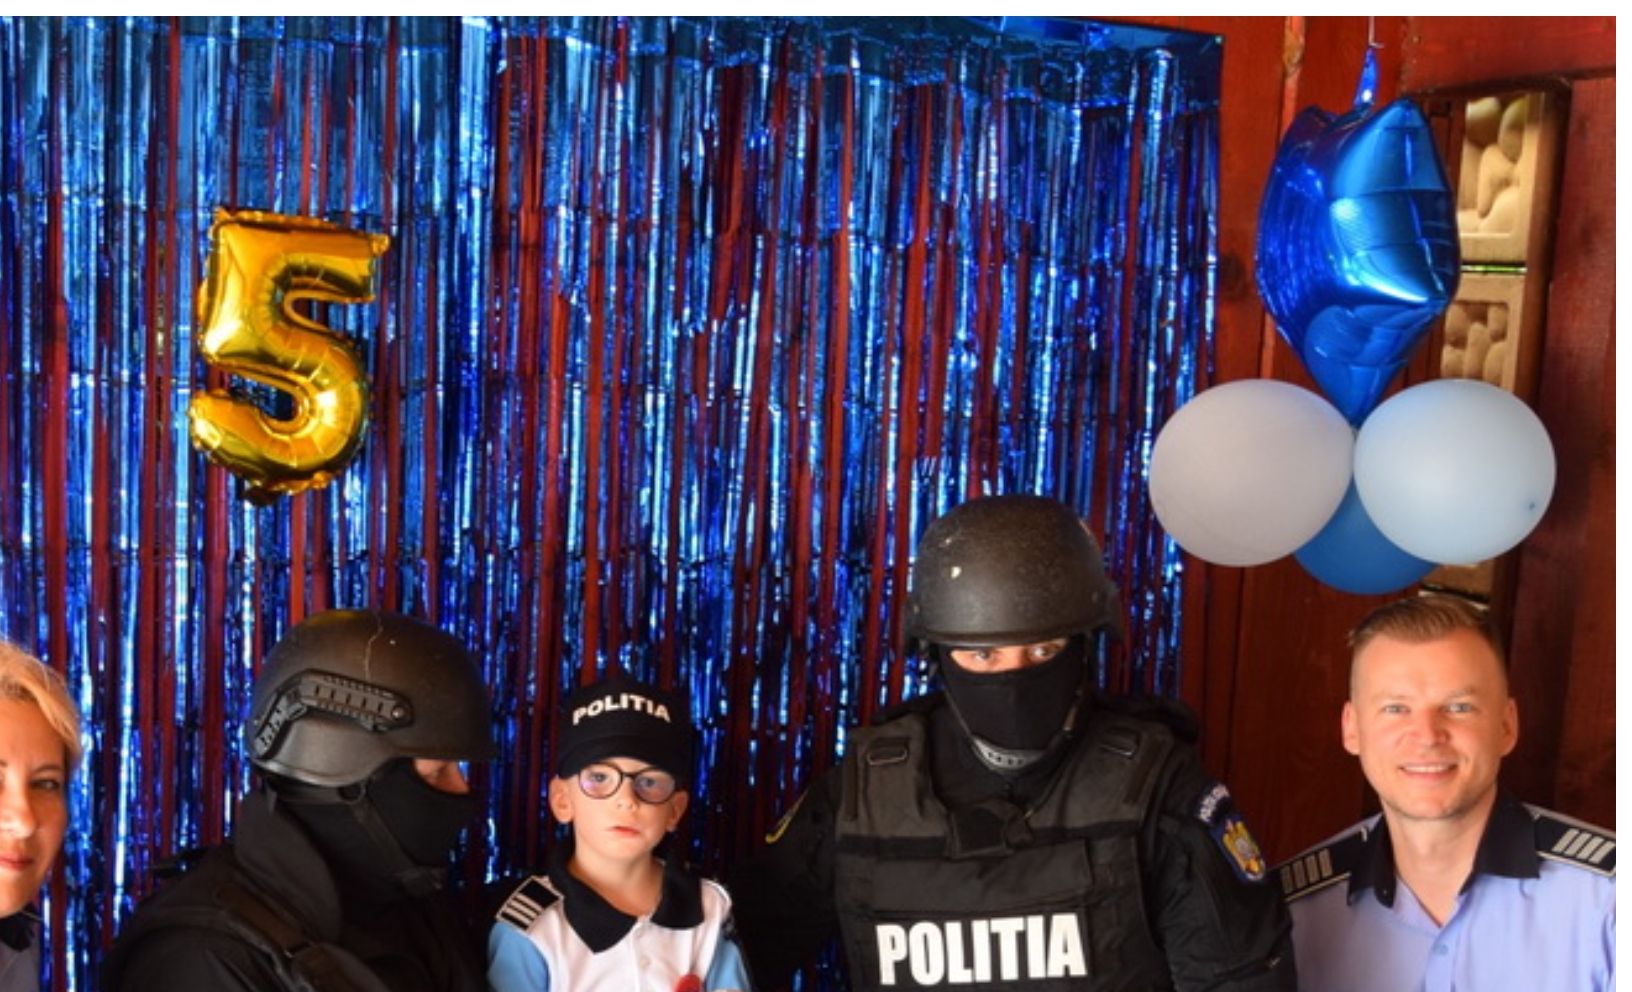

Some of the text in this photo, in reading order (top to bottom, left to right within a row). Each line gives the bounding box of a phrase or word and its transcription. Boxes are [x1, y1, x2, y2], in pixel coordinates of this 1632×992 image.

[187, 207, 389, 505] 5
[573, 692, 671, 725] POLITIA
[875, 913, 1087, 986] POLITIA
